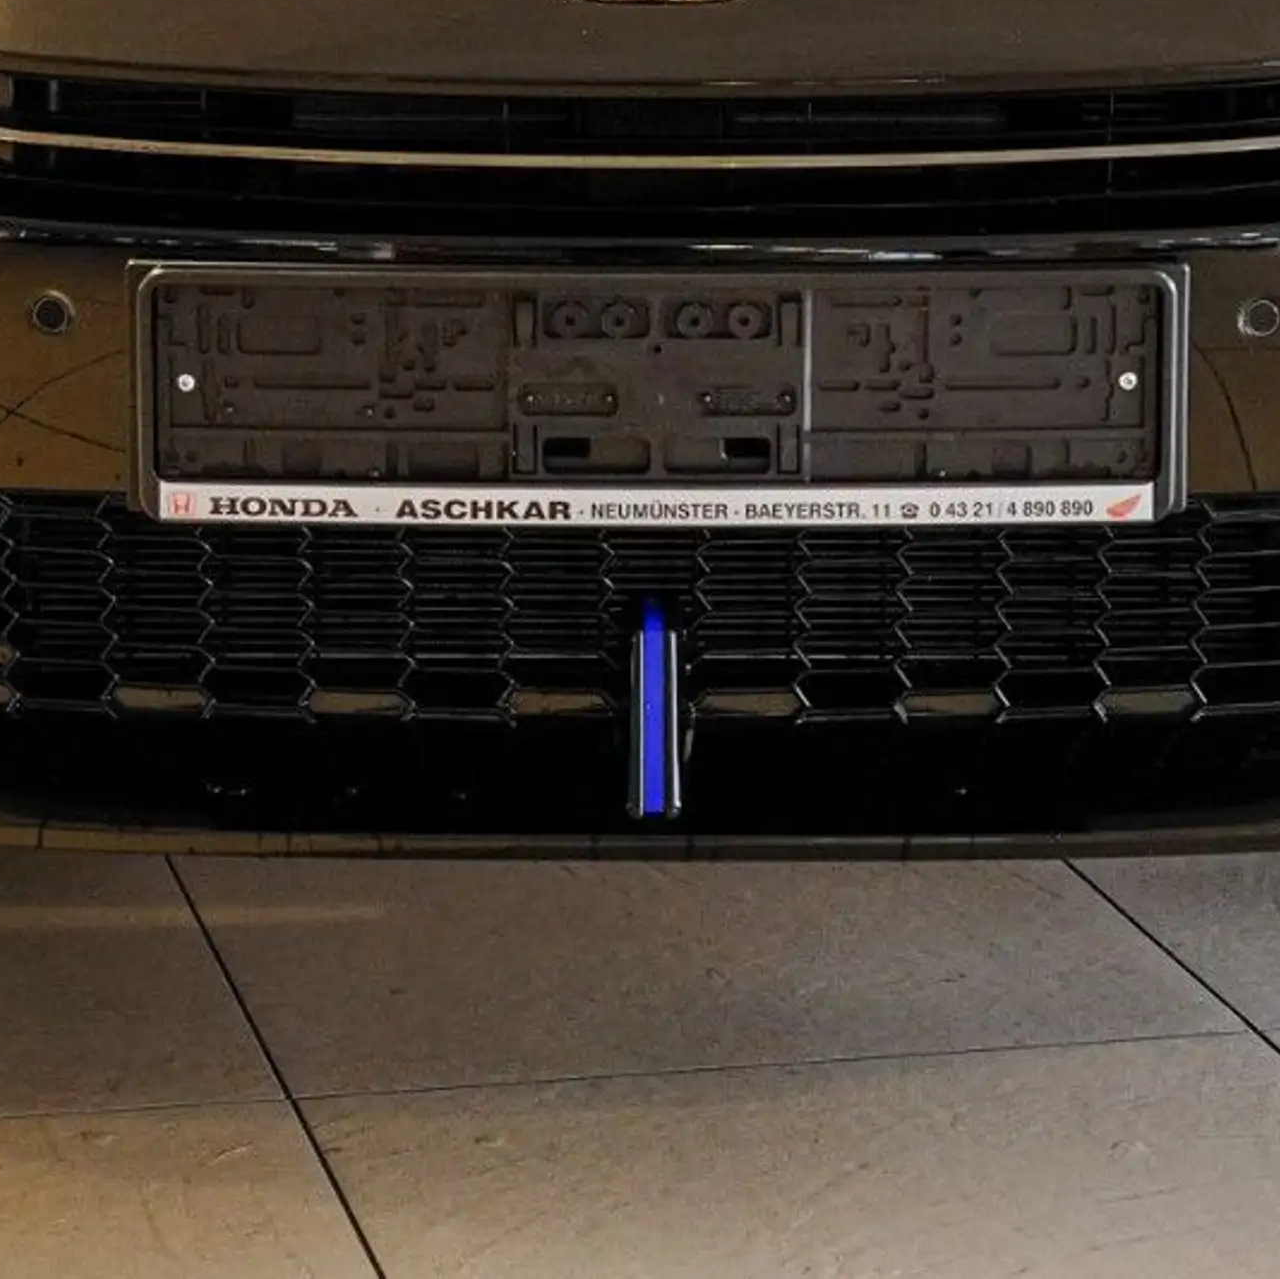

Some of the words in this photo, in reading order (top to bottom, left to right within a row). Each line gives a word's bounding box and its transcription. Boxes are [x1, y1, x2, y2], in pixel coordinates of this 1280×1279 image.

[208, 496, 358, 518] HONDA
[395, 499, 572, 520] ASCHKAR
[591, 499, 729, 520] NEUMÜNSTER
